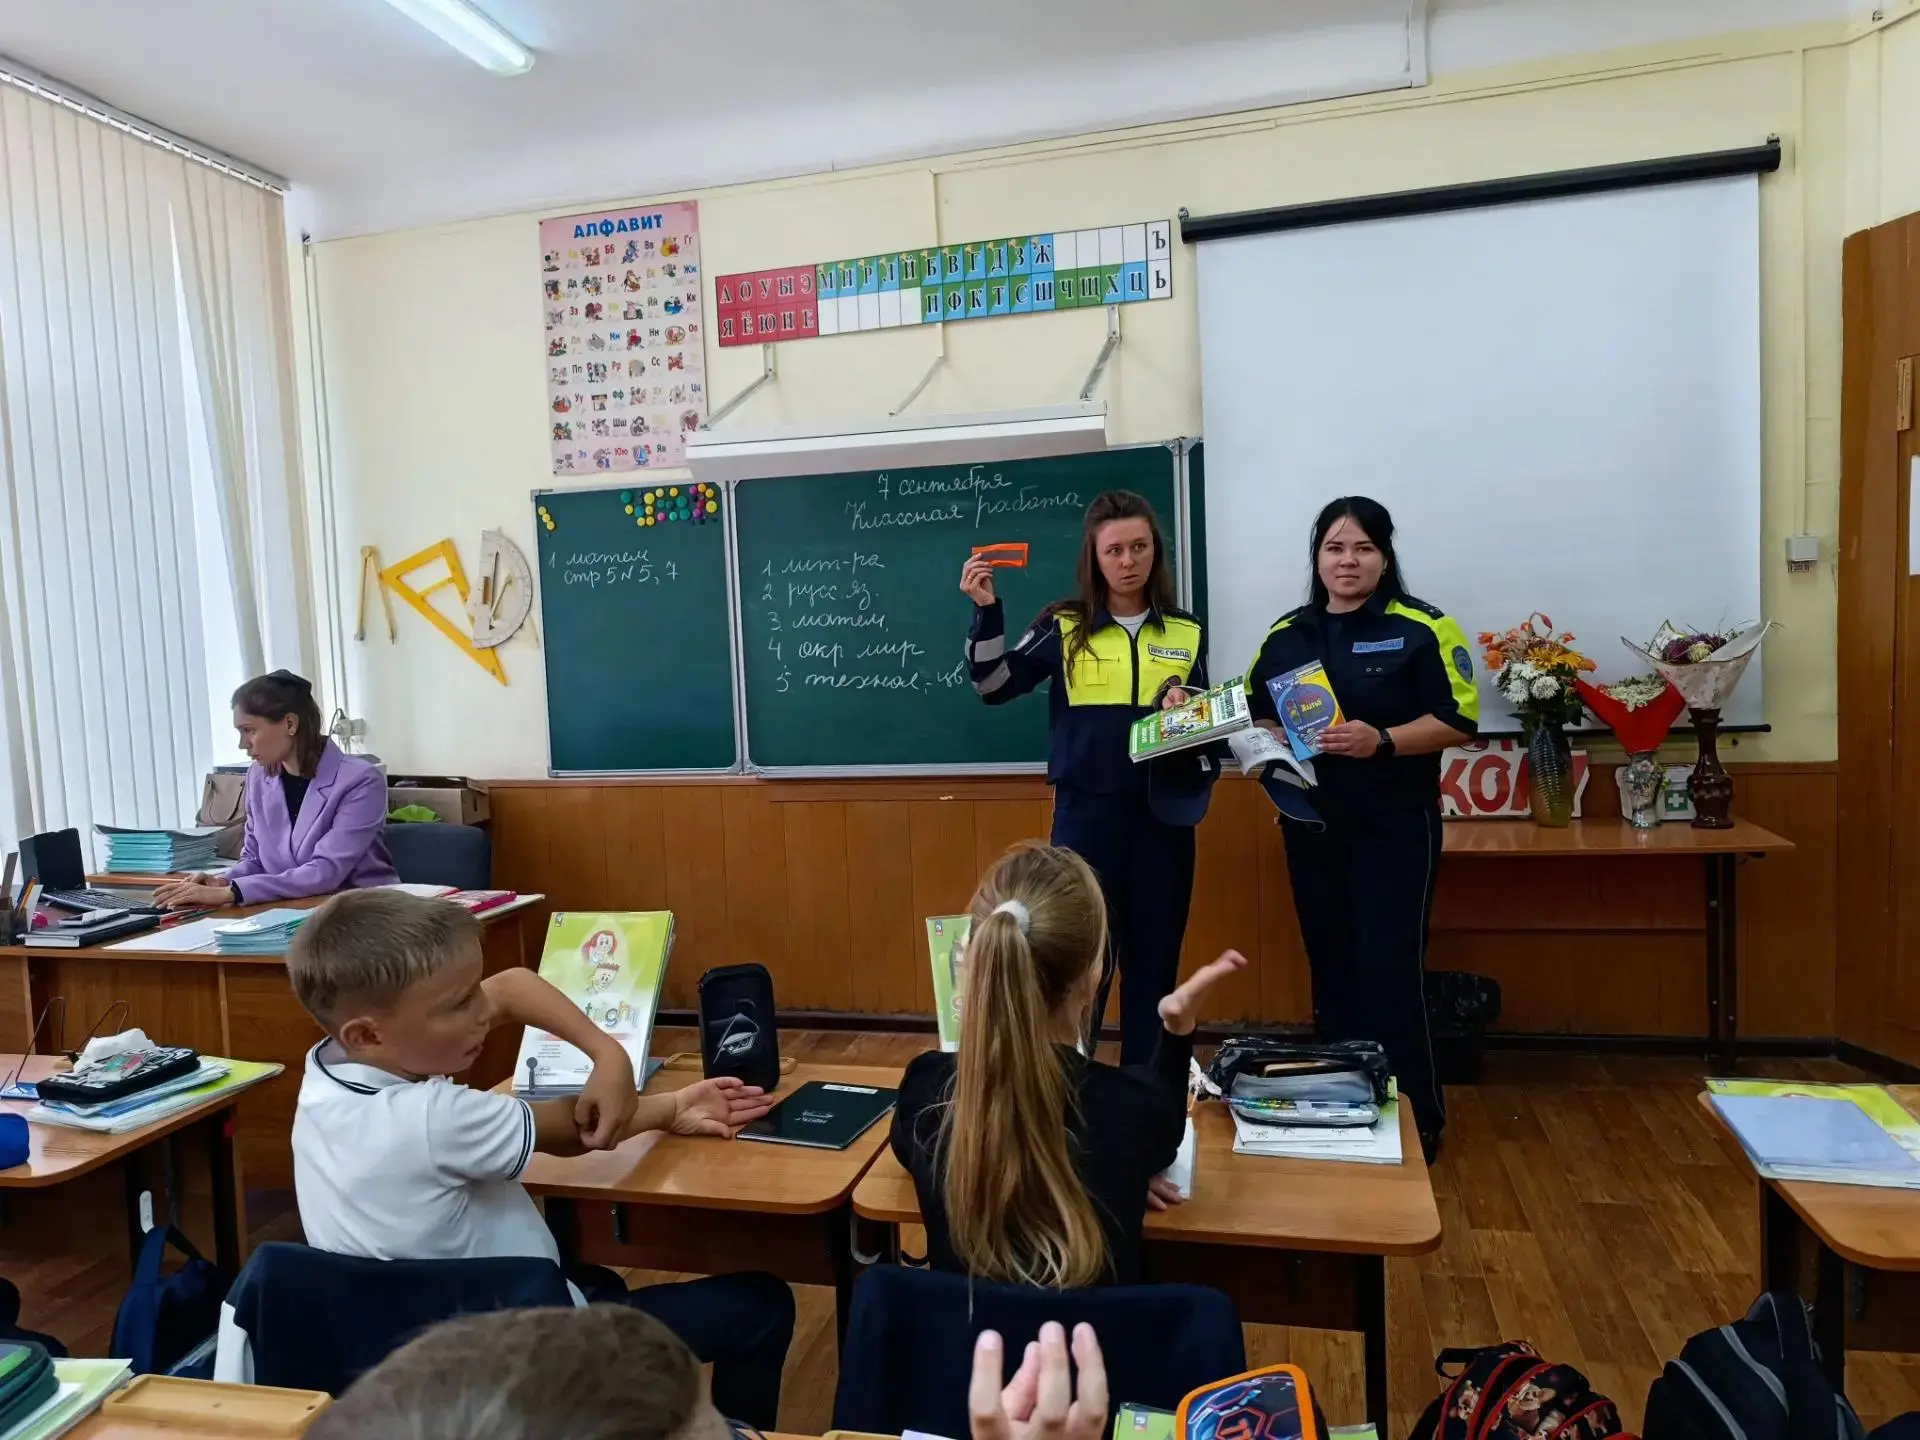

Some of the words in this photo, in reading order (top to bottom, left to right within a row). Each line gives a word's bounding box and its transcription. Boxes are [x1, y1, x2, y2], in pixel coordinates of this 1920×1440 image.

[574, 214, 663, 238] АЛФАВИТ
[740, 281, 752, 301] О
[777, 275, 795, 297] Ы
[800, 273, 813, 294] Э
[819, 269, 834, 292] М
[863, 265, 873, 285] Р
[903, 254, 916, 280] Й
[926, 257, 937, 277] Б
[948, 254, 959, 274] В
[970, 251, 980, 272] Г
[991, 247, 1004, 274] Д
[1015, 246, 1025, 266] З
[1034, 244, 1052, 264] Ж
[1152, 230, 1166, 249] Ъ
[722, 318, 734, 338] Я
[758, 312, 777, 334] Ю
[802, 308, 814, 329] Е
[926, 293, 939, 314] П
[947, 291, 961, 311] Ф
[970, 288, 983, 309] К
[992, 286, 1003, 306] Т
[1015, 283, 1028, 304] С
[1035, 281, 1053, 301] Ш
[1060, 279, 1073, 299] Ч
[1080, 276, 1101, 301] Щ
[1106, 273, 1119, 295] Х
[1130, 271, 1144, 293] Ц
[1155, 270, 1166, 289] Ь
[878, 473, 889, 499] 7
[899, 466, 1012, 498] сентября
[847, 499, 963, 530] Классная
[976, 485, 1084, 528] работа
[548, 551, 556, 568] 1
[607, 566, 618, 584] 5
[666, 561, 679, 581] 7
